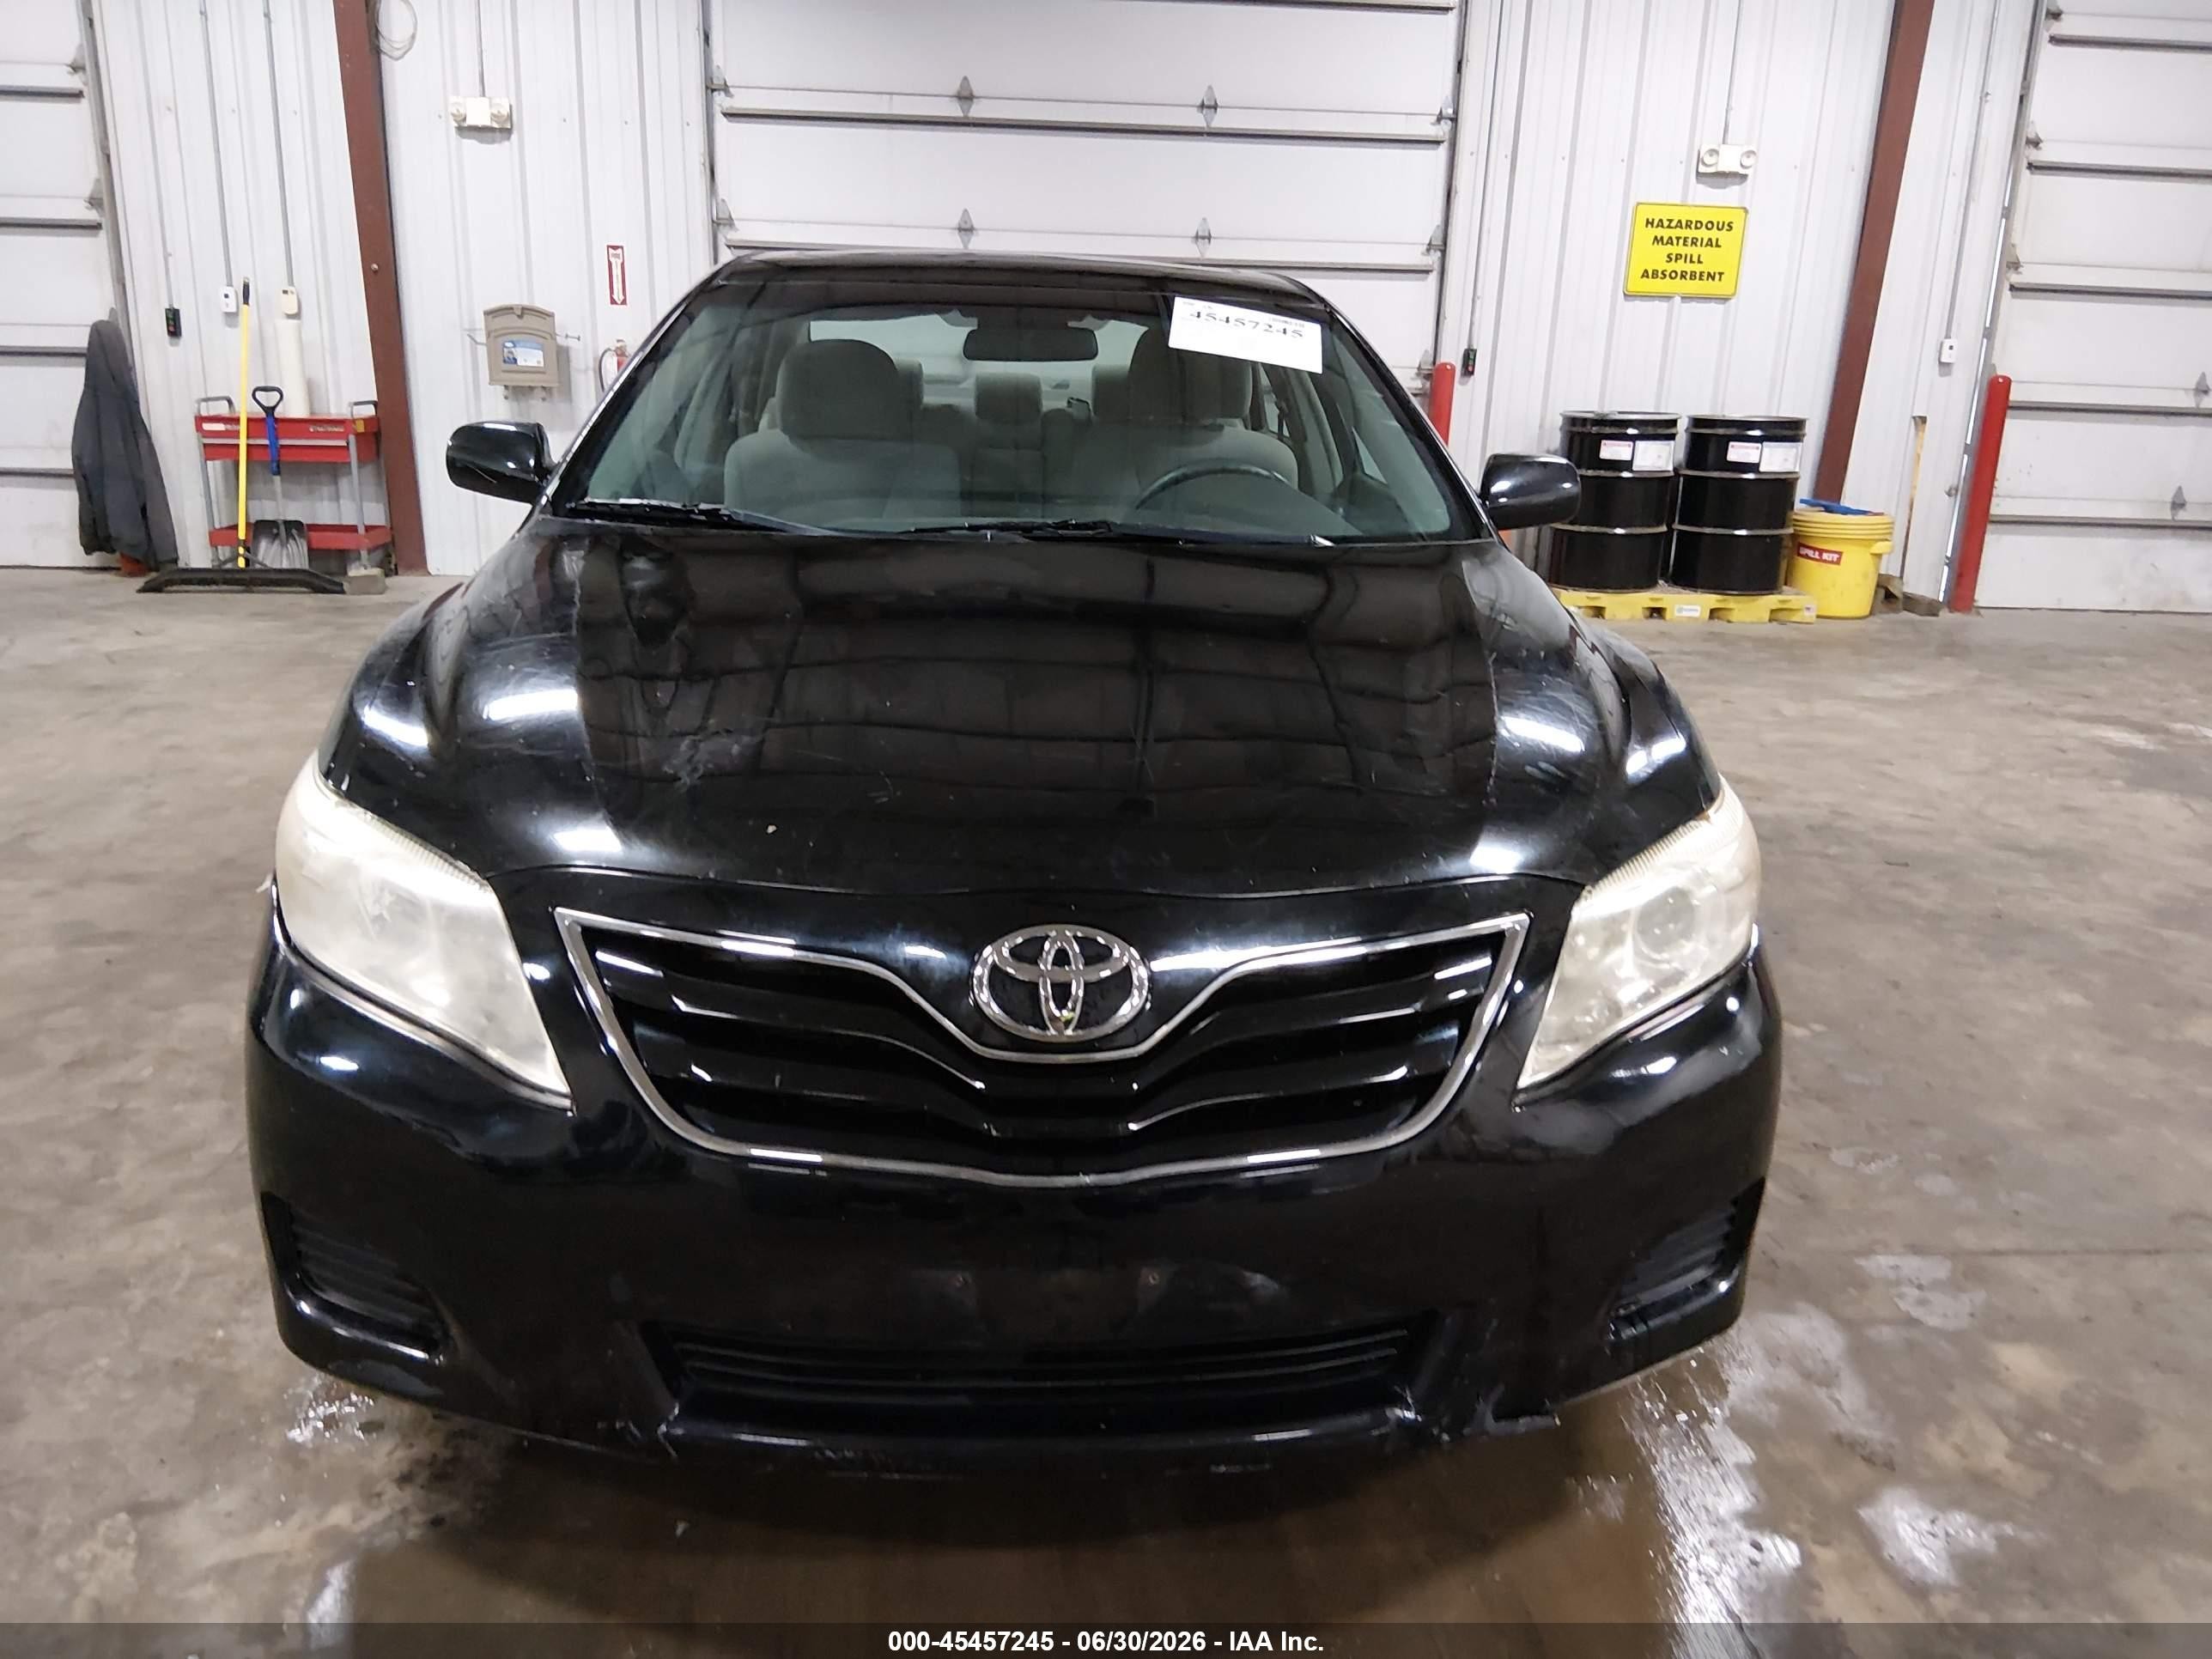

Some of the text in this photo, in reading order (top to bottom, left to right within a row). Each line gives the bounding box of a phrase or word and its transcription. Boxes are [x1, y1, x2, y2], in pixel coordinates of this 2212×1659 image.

[1644, 217, 1734, 232] HAZARDOUS
[1651, 234, 1722, 248] MATERIAL
[1665, 252, 1704, 264] SPILL
[1640, 268, 1725, 282] ABSORBENT
[1189, 311, 1304, 338] 45457245
